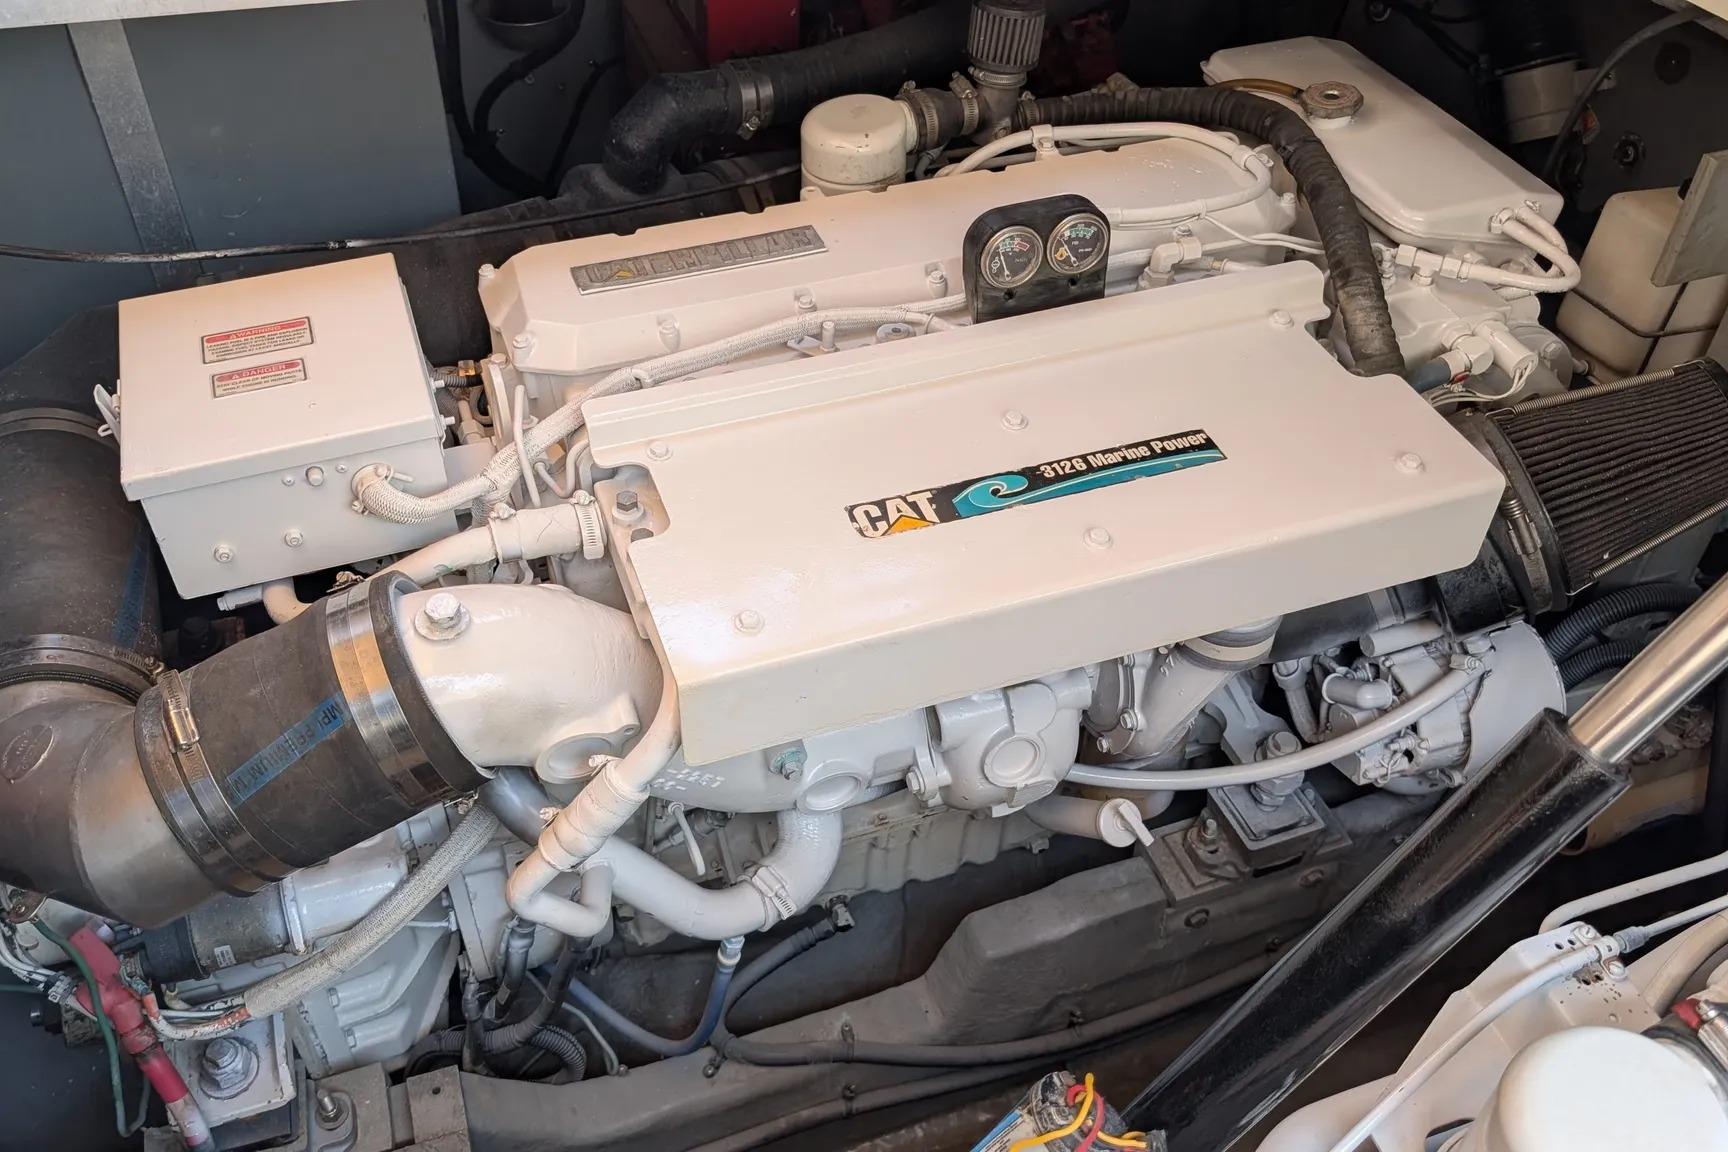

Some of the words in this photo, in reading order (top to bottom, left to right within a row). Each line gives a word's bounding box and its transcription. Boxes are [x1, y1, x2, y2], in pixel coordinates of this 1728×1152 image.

[584, 228, 815, 285] CATERPILLAR
[237, 325, 281, 339] WARNING
[242, 364, 286, 377] DANGER
[1040, 458, 1087, 478] 3126
[1086, 445, 1151, 469] Marine
[1150, 432, 1208, 454] Power
[852, 491, 940, 538] CAT
